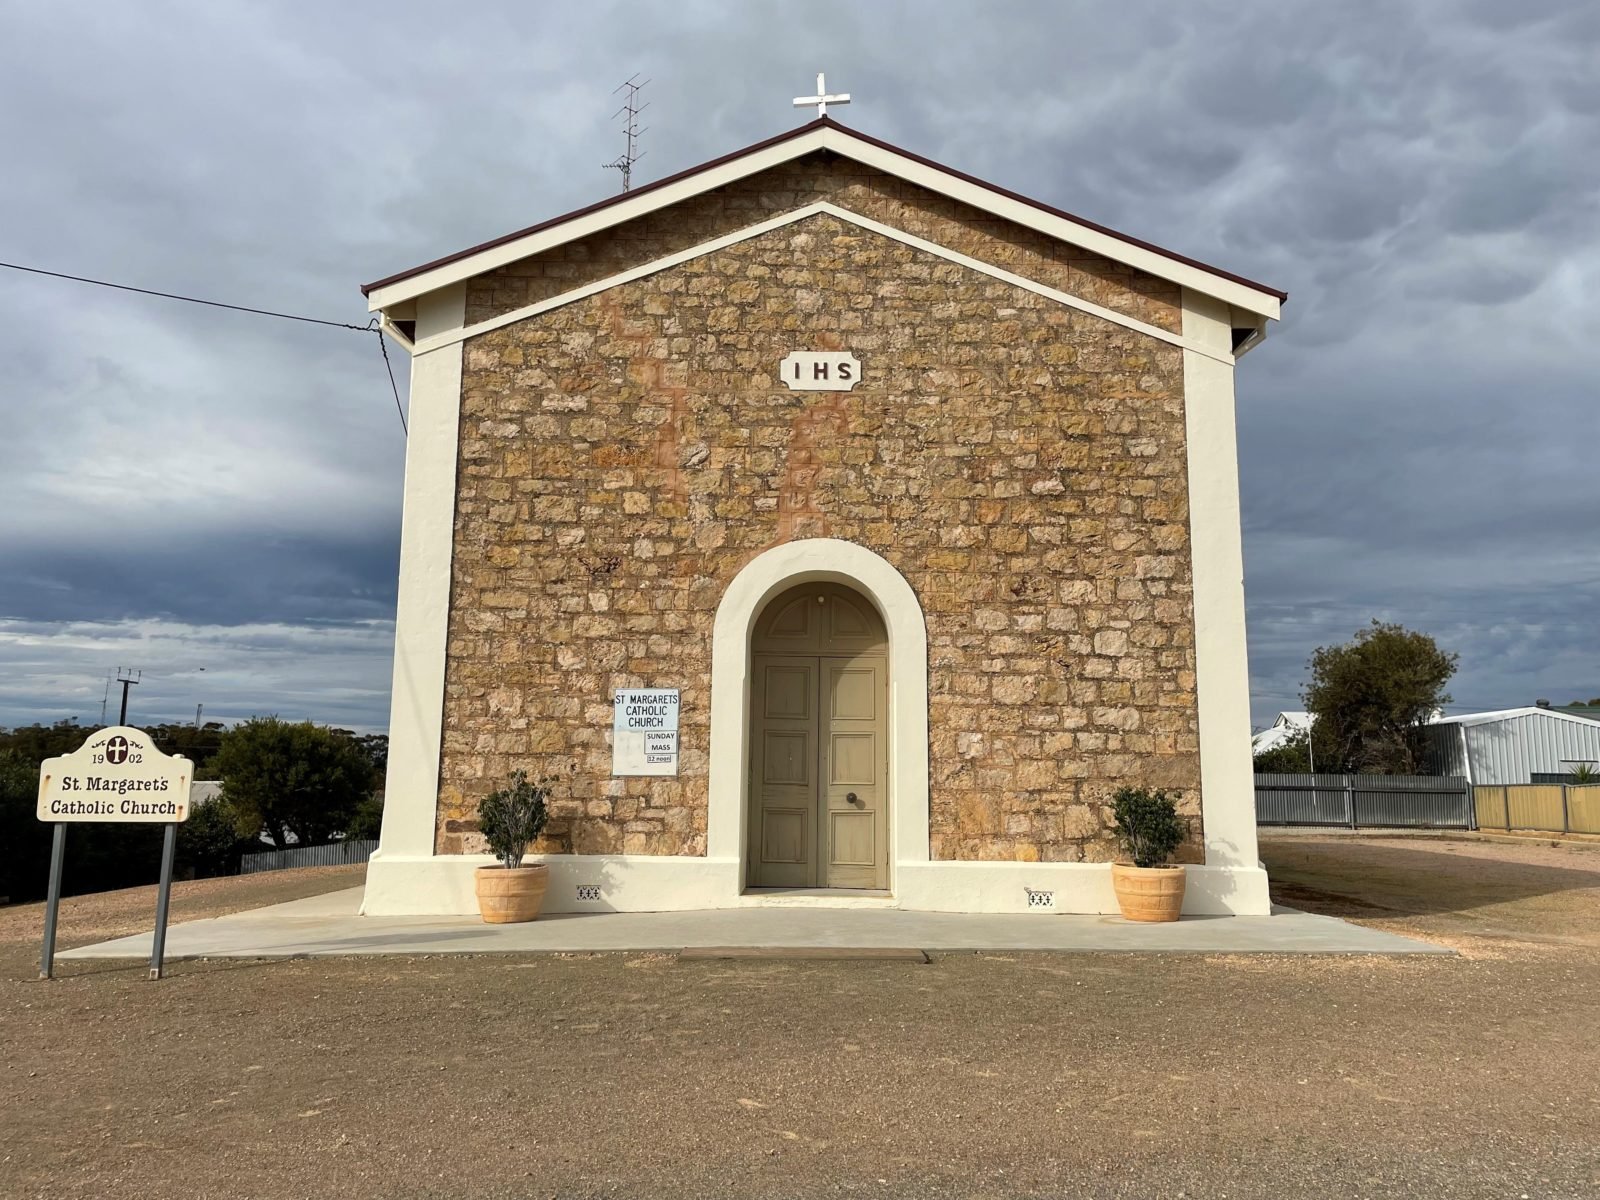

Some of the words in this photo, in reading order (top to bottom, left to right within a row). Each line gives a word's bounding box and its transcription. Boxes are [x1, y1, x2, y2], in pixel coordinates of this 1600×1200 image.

[794, 362, 852, 380] IHS
[615, 694, 625, 704] ST
[630, 694, 678, 704] MARGARETS
[625, 705, 667, 716] CATHOLIC
[628, 717, 663, 727] CHURCH
[62, 776, 82, 791] St.
[86, 776, 169, 795] Margaret's
[51, 799, 114, 814] Catholic
[120, 800, 176, 815] Church
